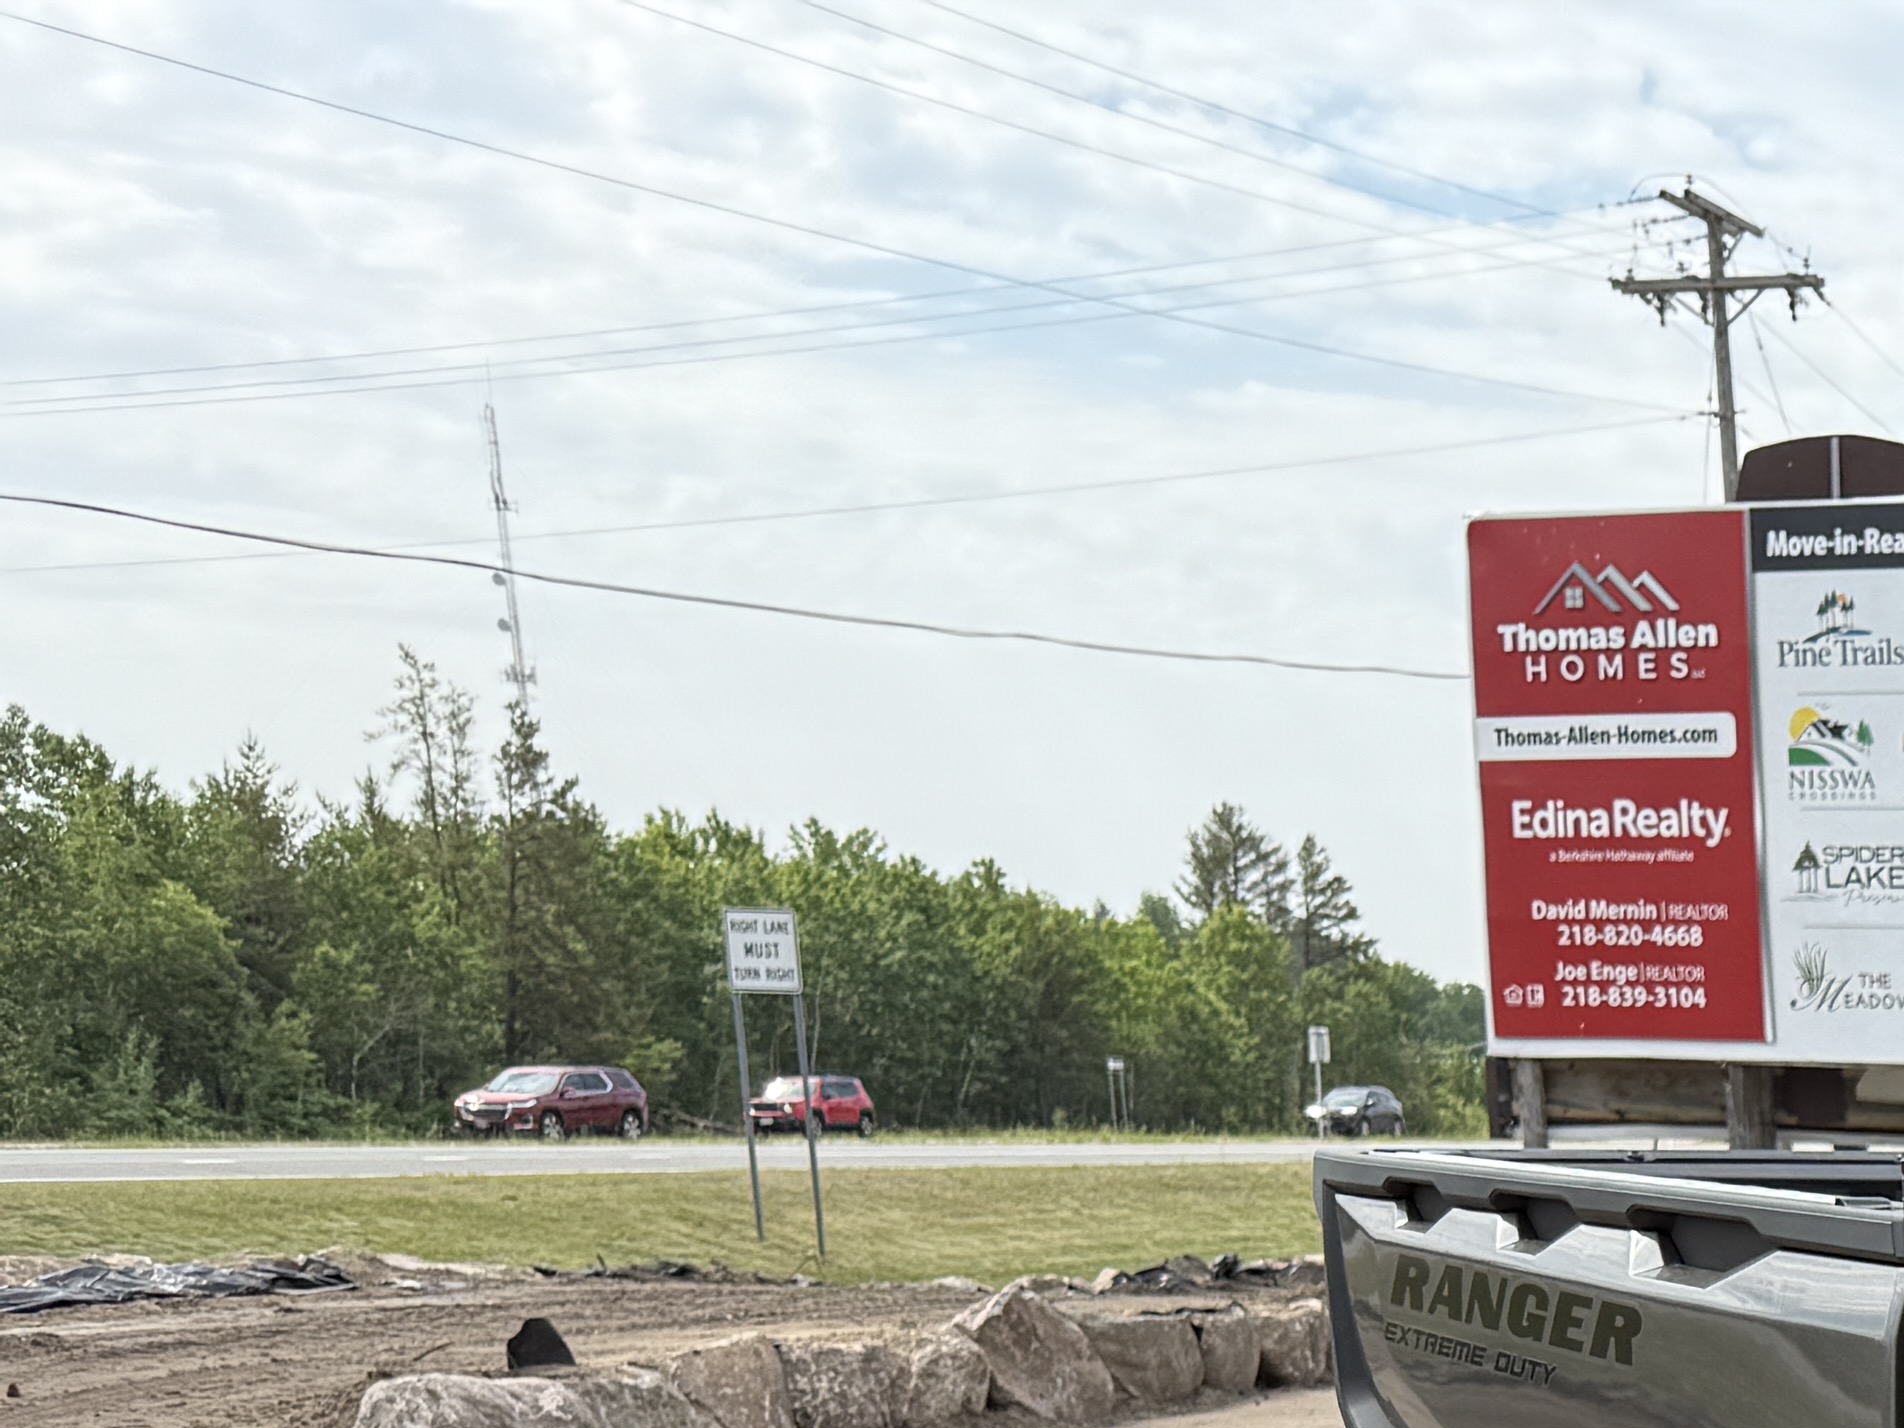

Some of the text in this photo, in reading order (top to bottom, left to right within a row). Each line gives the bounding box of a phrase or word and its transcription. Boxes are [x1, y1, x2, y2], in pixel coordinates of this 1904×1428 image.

[1497, 617, 1719, 652] Thomas Allen
[1777, 640, 1832, 668] Pine
[1525, 652, 1690, 683] HOMES
[1494, 725, 1718, 747] Thomas-Allen-Homes.com
[1788, 769, 1876, 791] NISSWA
[1531, 899, 1585, 920] David
[1589, 899, 1657, 920] Mernin
[1557, 924, 1703, 947] 218-820-4668
[1554, 961, 1587, 982] Joe
[1590, 960, 1638, 985] Enge
[1858, 972, 1892, 989] THE
[1561, 986, 1707, 1008] 218-839-3104
[1390, 1256, 1644, 1367] RANGER
[1383, 1321, 1558, 1387] EXTREME DUTY
